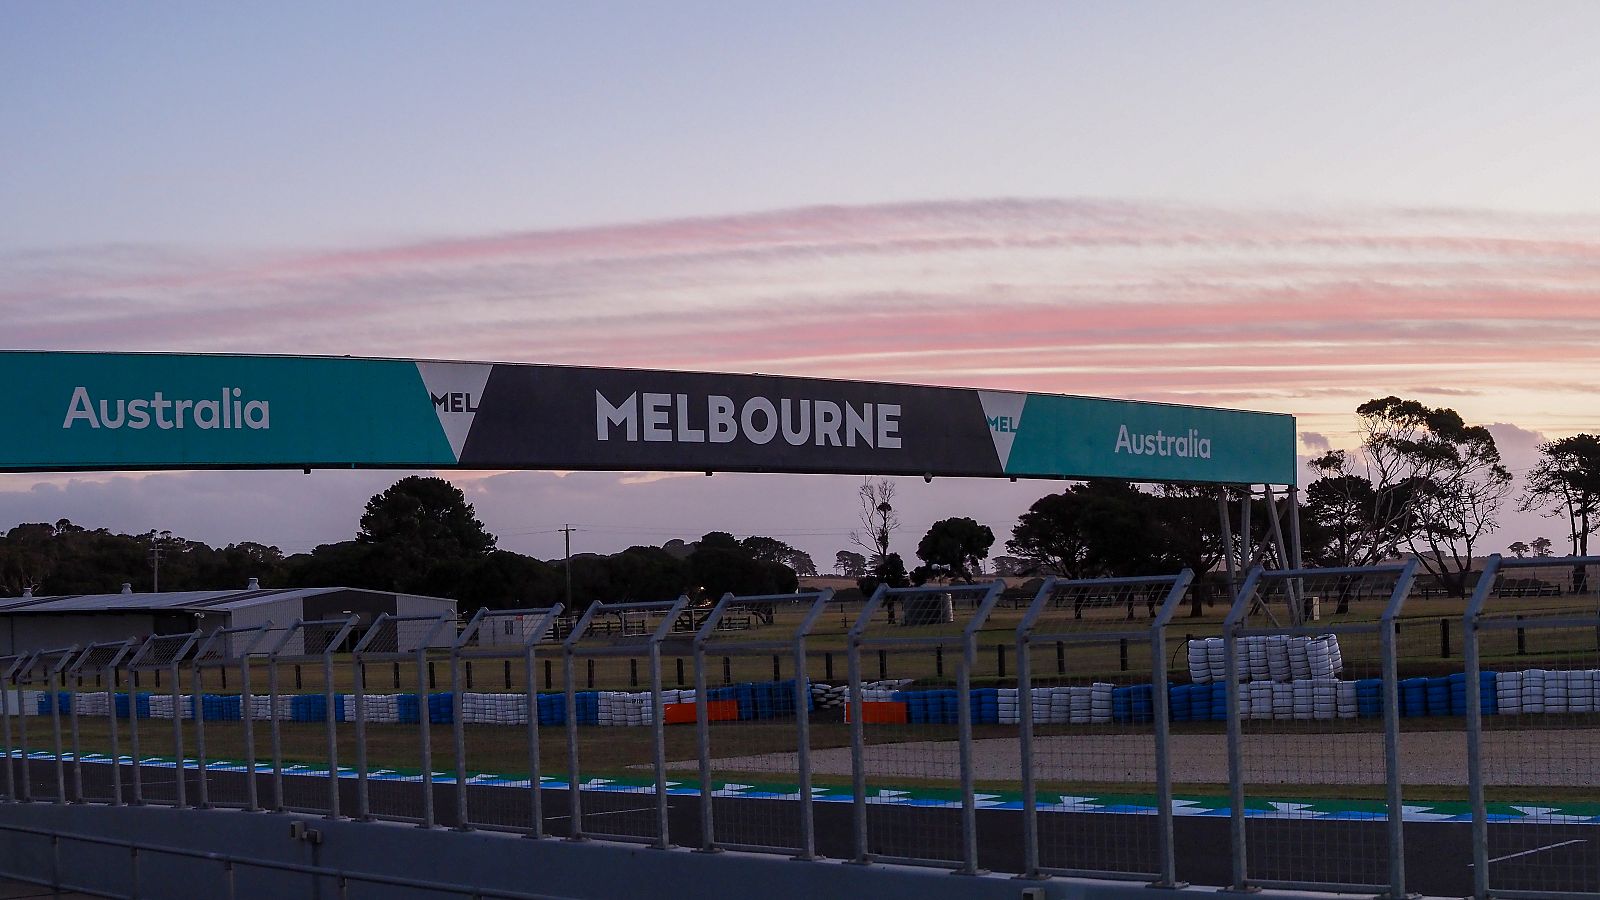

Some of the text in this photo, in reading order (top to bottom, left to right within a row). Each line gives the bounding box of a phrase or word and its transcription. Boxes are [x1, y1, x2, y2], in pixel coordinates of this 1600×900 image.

[62, 386, 270, 430] Australia
[430, 392, 478, 413] MEL
[595, 388, 902, 450] MELBOURNE
[986, 415, 1018, 433] MEL
[1114, 424, 1212, 460] Australia
